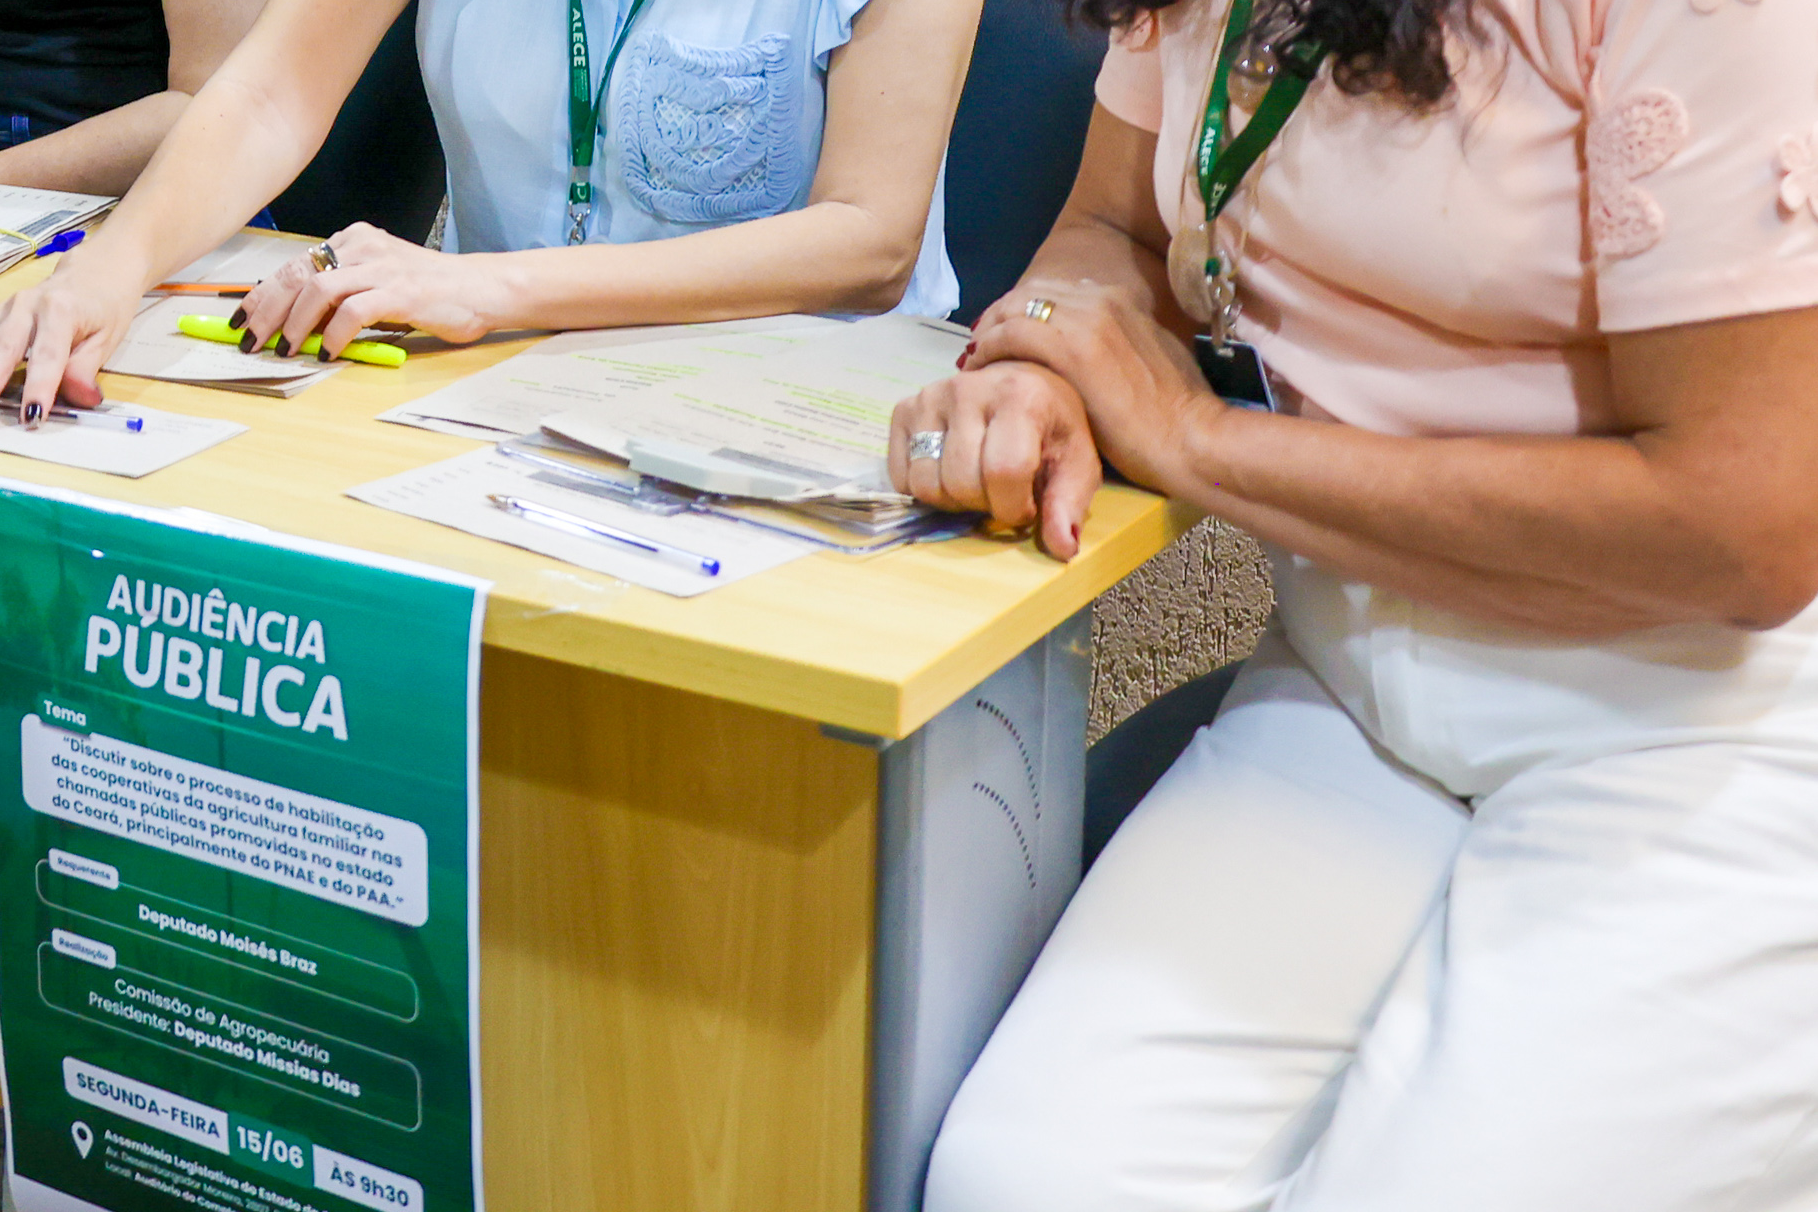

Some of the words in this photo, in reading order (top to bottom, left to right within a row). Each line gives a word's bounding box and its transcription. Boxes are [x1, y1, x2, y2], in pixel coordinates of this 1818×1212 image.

[572, 7, 586, 68] ALECE
[106, 573, 327, 665] AUDIÊNCIA
[44, 700, 86, 725] Tema
[84, 611, 350, 742] PÚBLICA
[51, 754, 77, 772] das
[81, 765, 179, 803] cooperativas
[183, 795, 203, 810] da
[207, 803, 297, 837] agricultura
[302, 826, 366, 856] familiar
[372, 850, 402, 867] nas
[52, 794, 70, 809] do
[73, 800, 122, 827] Ceará,
[126, 819, 246, 862] principalmente
[250, 855, 269, 869] do
[274, 860, 314, 883] PNAE
[319, 877, 327, 887] e
[332, 879, 352, 895] do
[57, 777, 136, 810] chamadas
[140, 803, 206, 831] públicas
[210, 824, 307, 860] promovidas
[312, 853, 331, 868] no
[336, 861, 393, 886] estado
[130, 759, 172, 780] sobre
[176, 773, 185, 784] o
[189, 777, 260, 805] processo
[264, 797, 284, 813] de
[288, 802, 383, 840] habilitação
[139, 904, 217, 942] Deputado
[220, 930, 277, 961] Moisés
[280, 949, 317, 974] Braz
[89, 991, 170, 1032] Presidente:
[174, 1021, 254, 1060] Deputado
[257, 1049, 319, 1083] Missias
[322, 1071, 360, 1096] Dias
[115, 979, 191, 1016] Comissão
[195, 1007, 215, 1025] de
[219, 1014, 329, 1063] Agropecuária
[77, 1073, 219, 1137] SEGUNDA-FEIRA
[237, 1126, 303, 1168] 15/06
[331, 1161, 355, 1188] ÀS
[360, 1176, 408, 1206] 9h30
